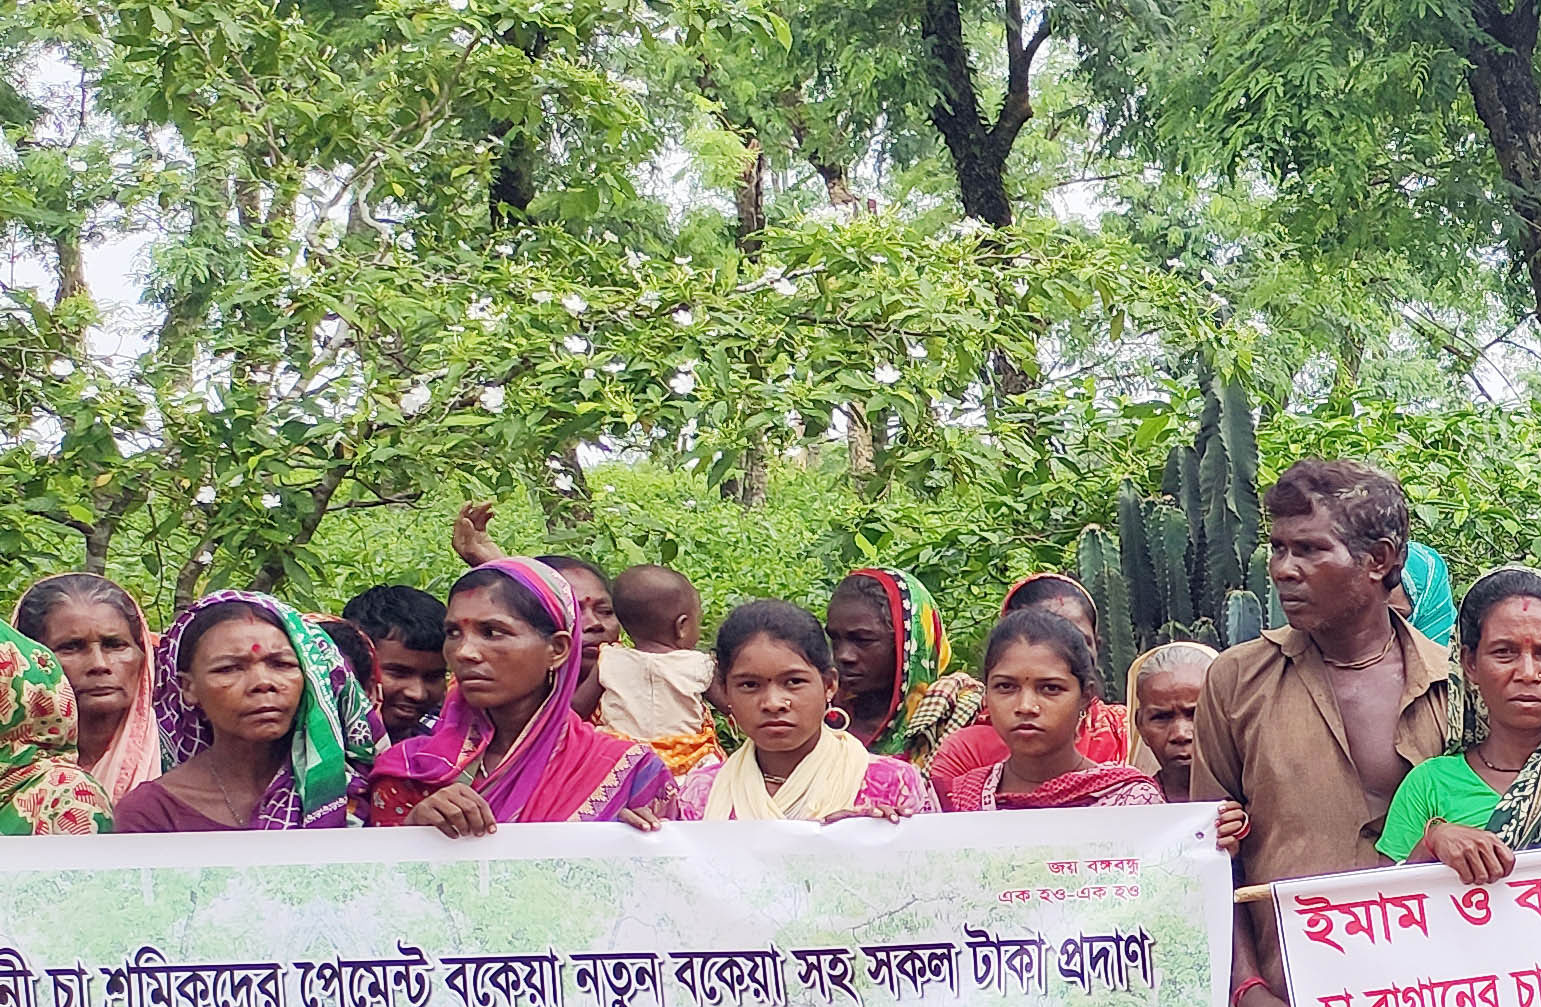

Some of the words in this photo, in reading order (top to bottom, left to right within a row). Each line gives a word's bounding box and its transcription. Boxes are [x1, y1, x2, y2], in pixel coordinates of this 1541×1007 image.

[1294, 892, 1428, 952] ইমাম
[1450, 888, 1492, 926] ও
[792, 949, 858, 1007] সহ
[860, 943, 962, 1004] সকল
[964, 923, 1042, 993] টাকা
[1059, 931, 1154, 992] প্রদাণ
